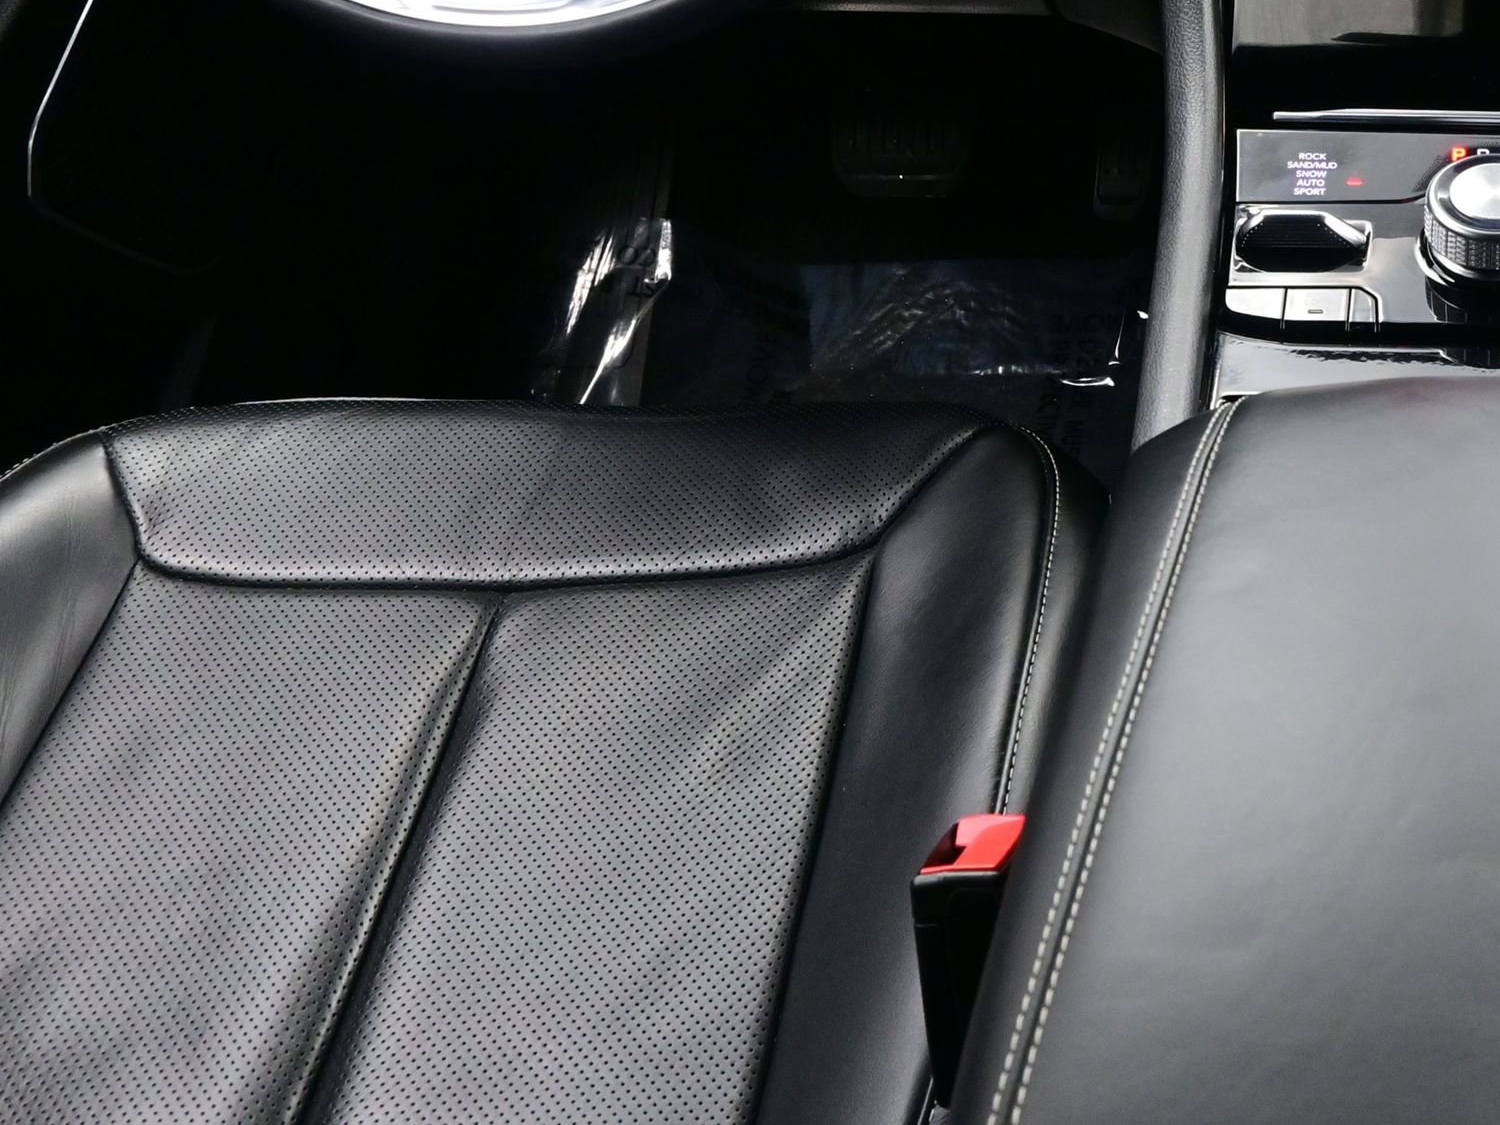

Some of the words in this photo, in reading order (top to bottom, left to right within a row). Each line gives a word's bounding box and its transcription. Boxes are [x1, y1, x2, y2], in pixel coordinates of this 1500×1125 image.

[1298, 152, 1327, 161] ROCK
[1452, 148, 1467, 162] P
[1287, 161, 1338, 169] SAND/MUD
[1295, 170, 1327, 178] SNOW
[1296, 179, 1325, 187] AUTO
[1293, 187, 1326, 196] SPORT
